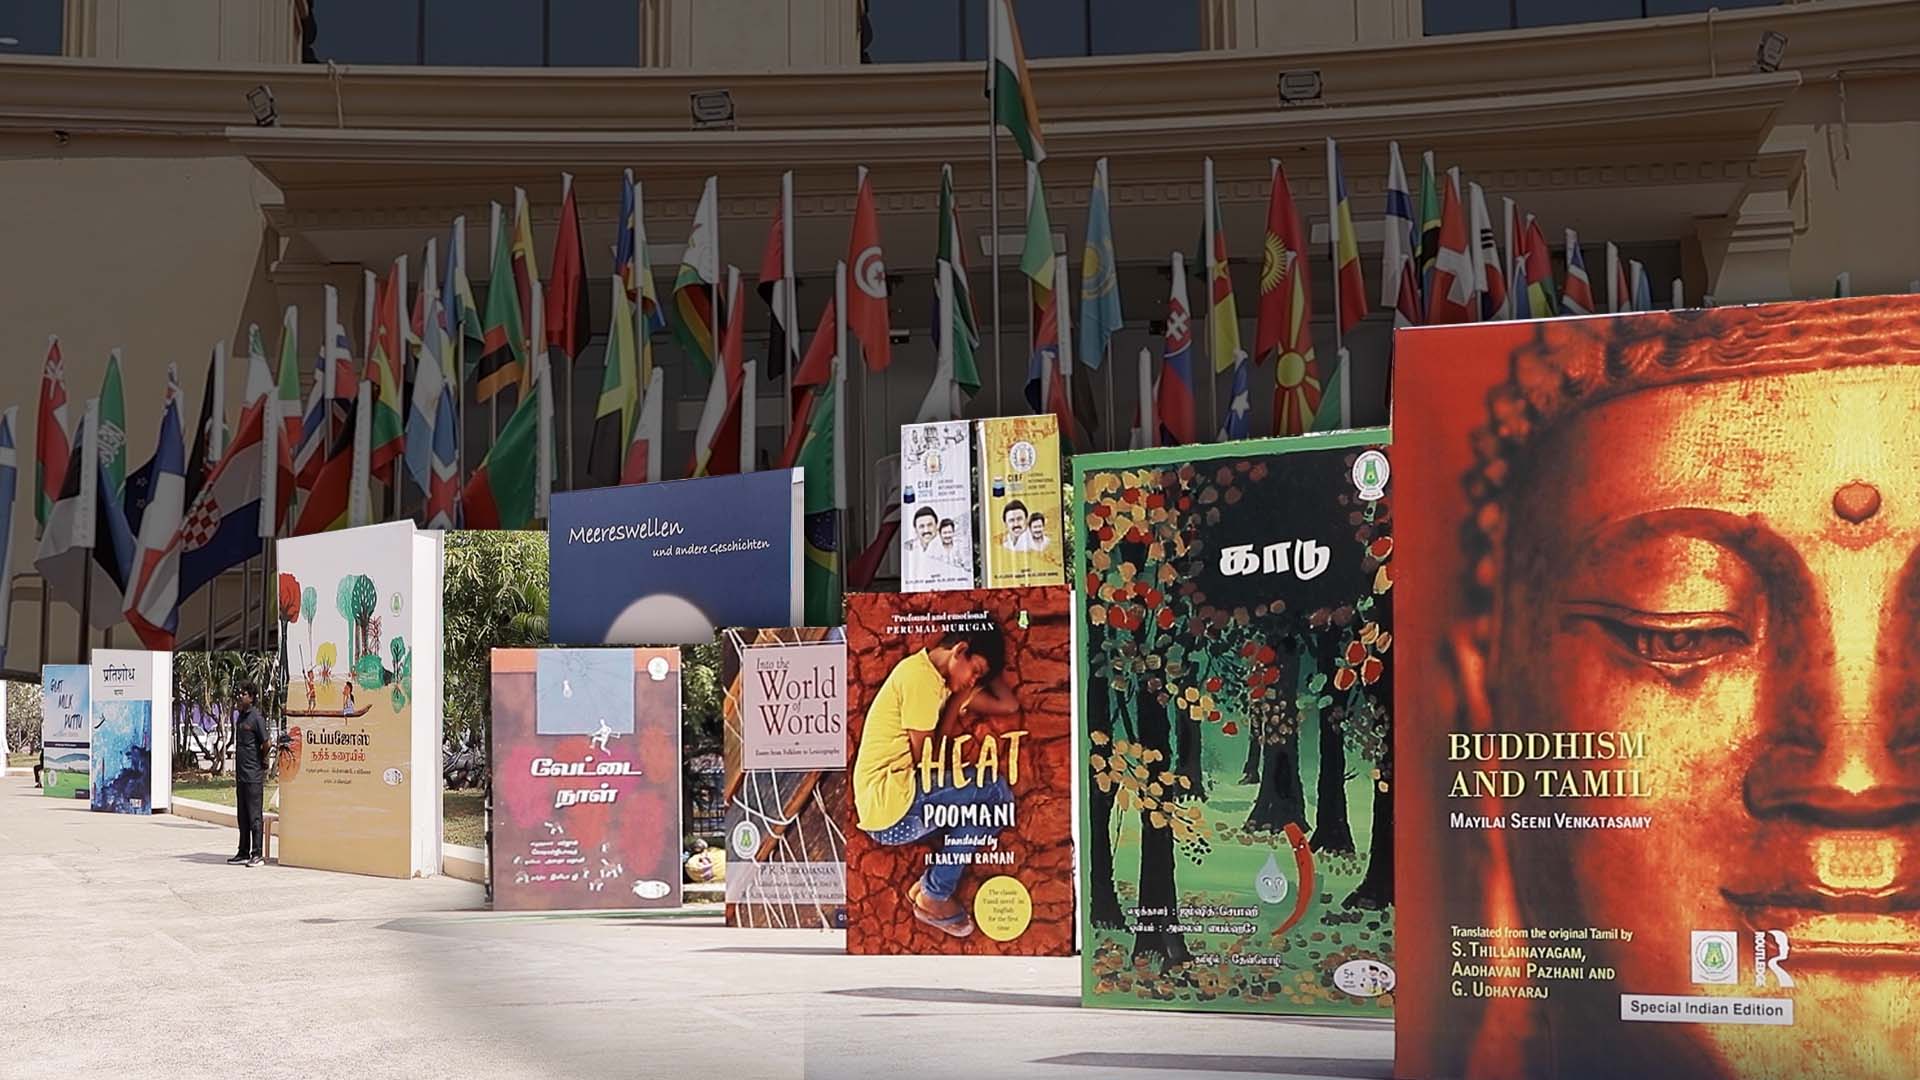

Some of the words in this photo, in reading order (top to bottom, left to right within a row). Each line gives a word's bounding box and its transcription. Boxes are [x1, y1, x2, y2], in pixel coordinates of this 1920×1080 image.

[568, 517, 684, 544] Meereswellen
[653, 546, 673, 557] und
[675, 543, 708, 556] andere
[709, 538, 770, 554] Geschichten
[1219, 538, 1331, 581] காடு
[931, 612, 946, 621] and
[886, 624, 937, 634] PERUMAL
[941, 622, 994, 633] MURUGAN
[103, 664, 135, 682] प्रतिशोध
[757, 658, 774, 670] Into
[776, 657, 790, 669] the
[758, 665, 836, 701] World
[792, 700, 801, 713] of
[758, 701, 841, 736] Words
[1448, 731, 1646, 761] BUDDHISM
[530, 756, 643, 777] வேட்டை
[917, 731, 1028, 794] HEAT
[1448, 770, 1526, 798] AND
[1534, 769, 1652, 798] TAMIL
[554, 783, 619, 808] நாள்
[923, 802, 1016, 828] POOMANI
[1450, 813, 1505, 829] MAYILAI
[1511, 813, 1550, 829] SEENI
[1554, 813, 1652, 829] VENKATASAMY
[944, 834, 987, 846] Translated
[987, 834, 998, 851] by
[935, 852, 972, 865] KALYAN
[975, 851, 1014, 865] RAMAN
[1451, 926, 1501, 939] Translated
[1504, 926, 1528, 939] from
[1531, 927, 1546, 939] the
[1549, 927, 1588, 941] original
[1589, 928, 1618, 940] Tamil
[1620, 928, 1633, 942] by
[1451, 941, 1466, 957] S.
[1451, 961, 1521, 977] AADHAVAN
[1526, 963, 1584, 979] PAZHANI
[1588, 967, 1616, 980] AND
[1451, 980, 1468, 997] G.
[1473, 981, 1549, 999] UDHAYARAJ
[1630, 999, 1681, 1015] Special
[1685, 1002, 1729, 1015] Indian
[1733, 1003, 1784, 1017] Edition
